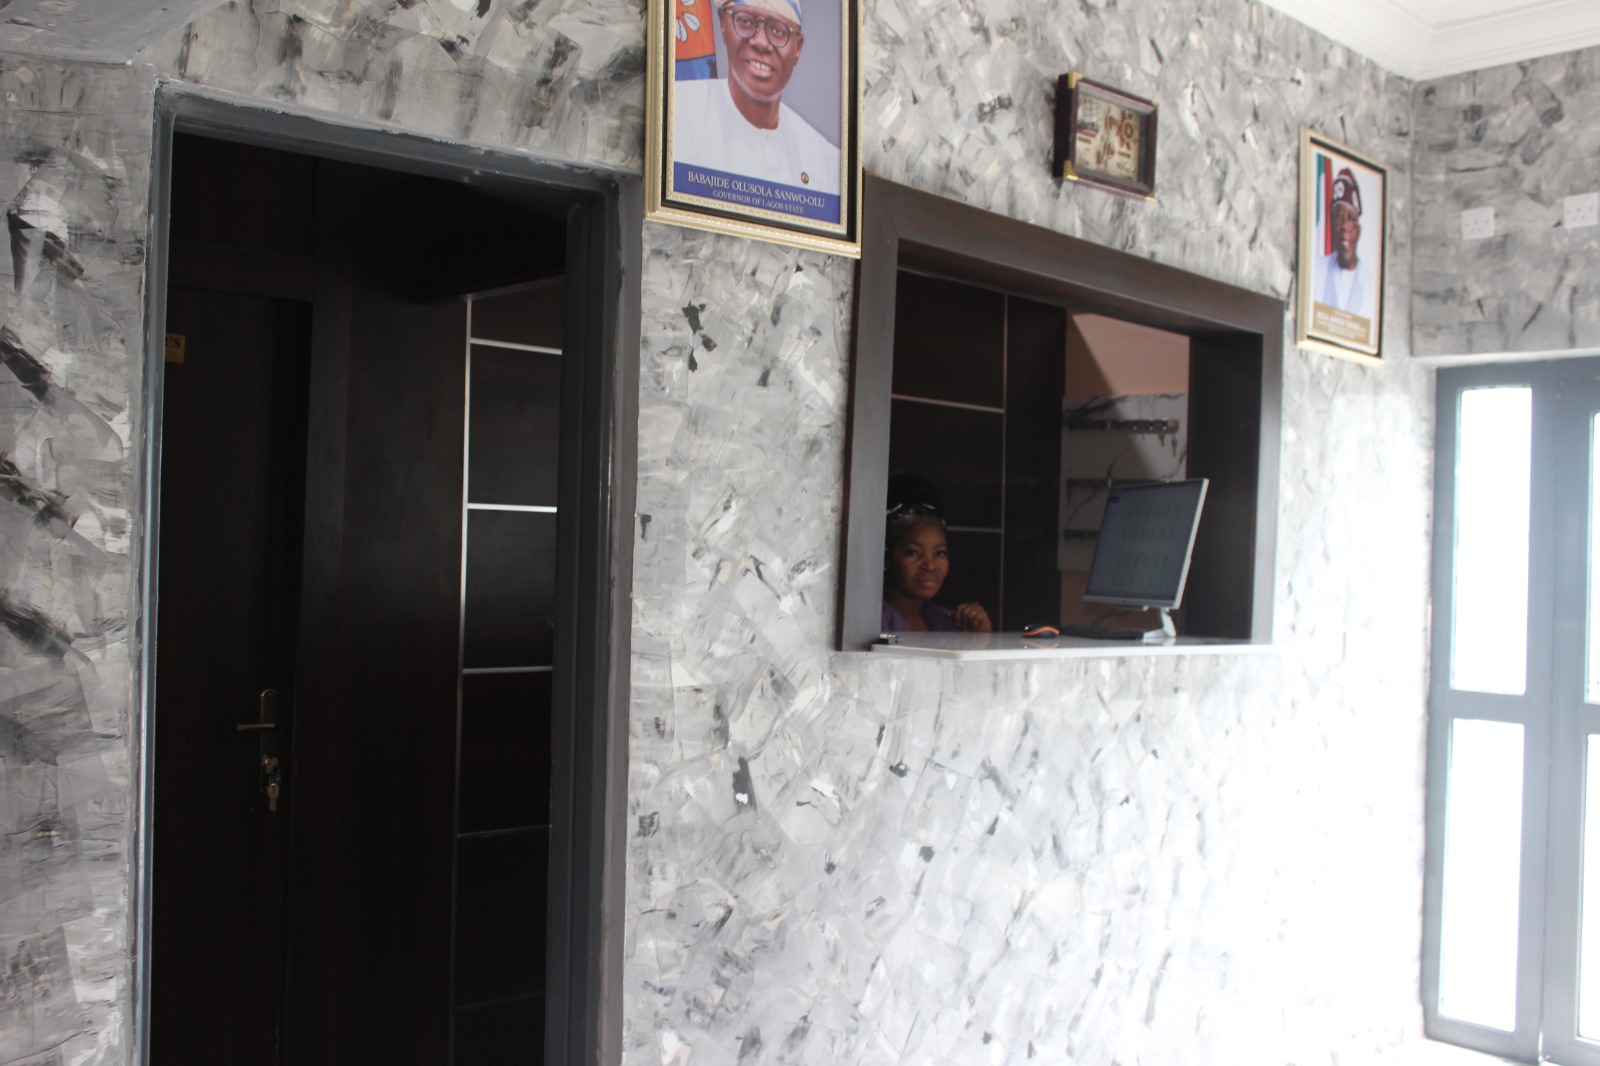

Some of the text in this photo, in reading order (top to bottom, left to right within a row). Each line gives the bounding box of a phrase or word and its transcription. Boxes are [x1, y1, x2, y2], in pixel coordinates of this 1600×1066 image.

[688, 171, 825, 207] BABAJIDE OLUSOLA SANWO-OLU
[713, 190, 804, 214] GOVERNOR OF LAGOS STATE
